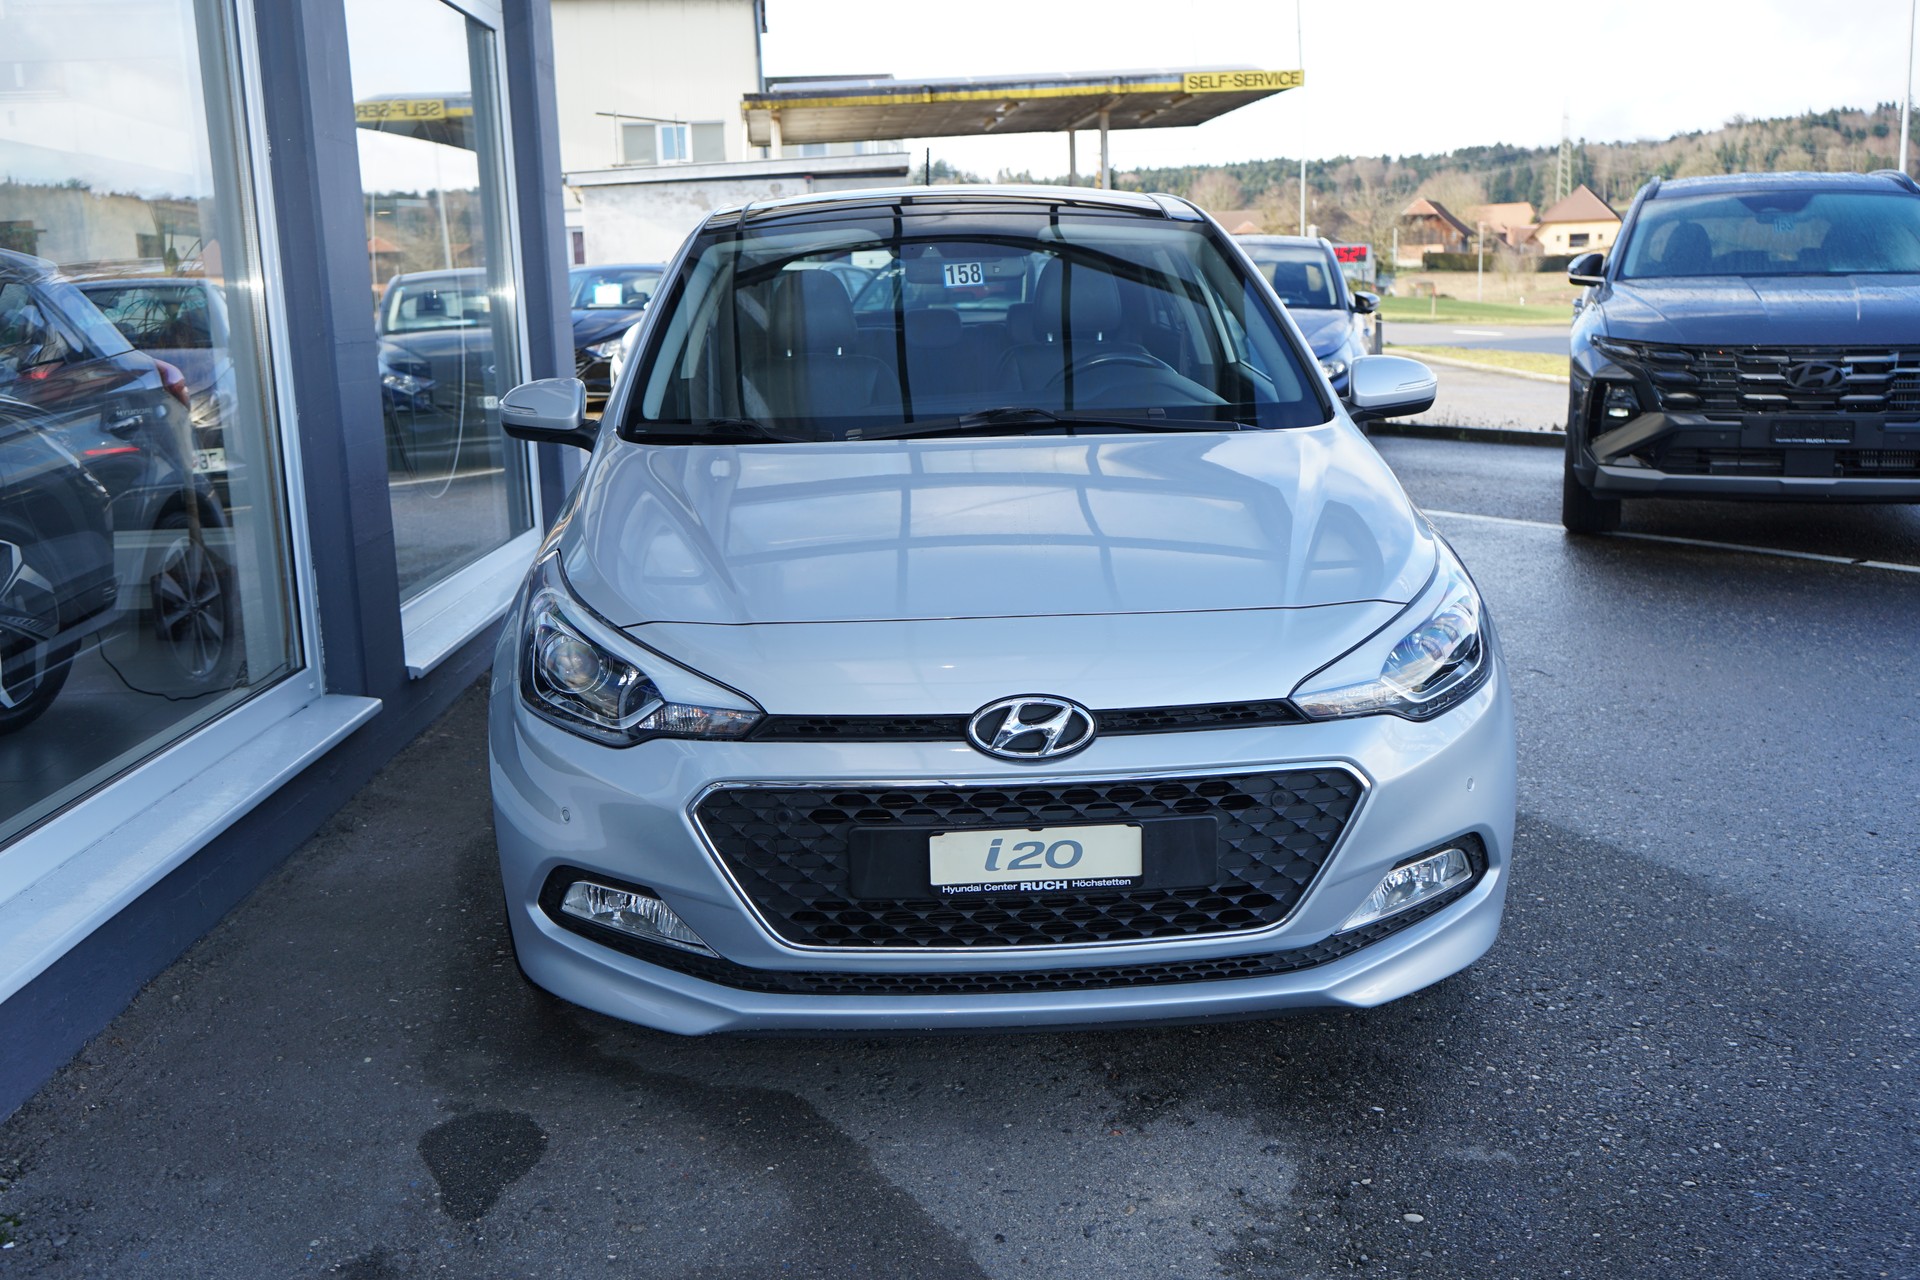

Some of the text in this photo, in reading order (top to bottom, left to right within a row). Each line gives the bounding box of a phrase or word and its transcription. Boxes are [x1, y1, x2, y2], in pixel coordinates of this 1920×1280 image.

[1188, 71, 1300, 90] SELF-SERVICE
[945, 263, 982, 285] 158
[984, 838, 1084, 872] i20
[942, 878, 1132, 895] Hyundai Center RUCH Höchstetten
